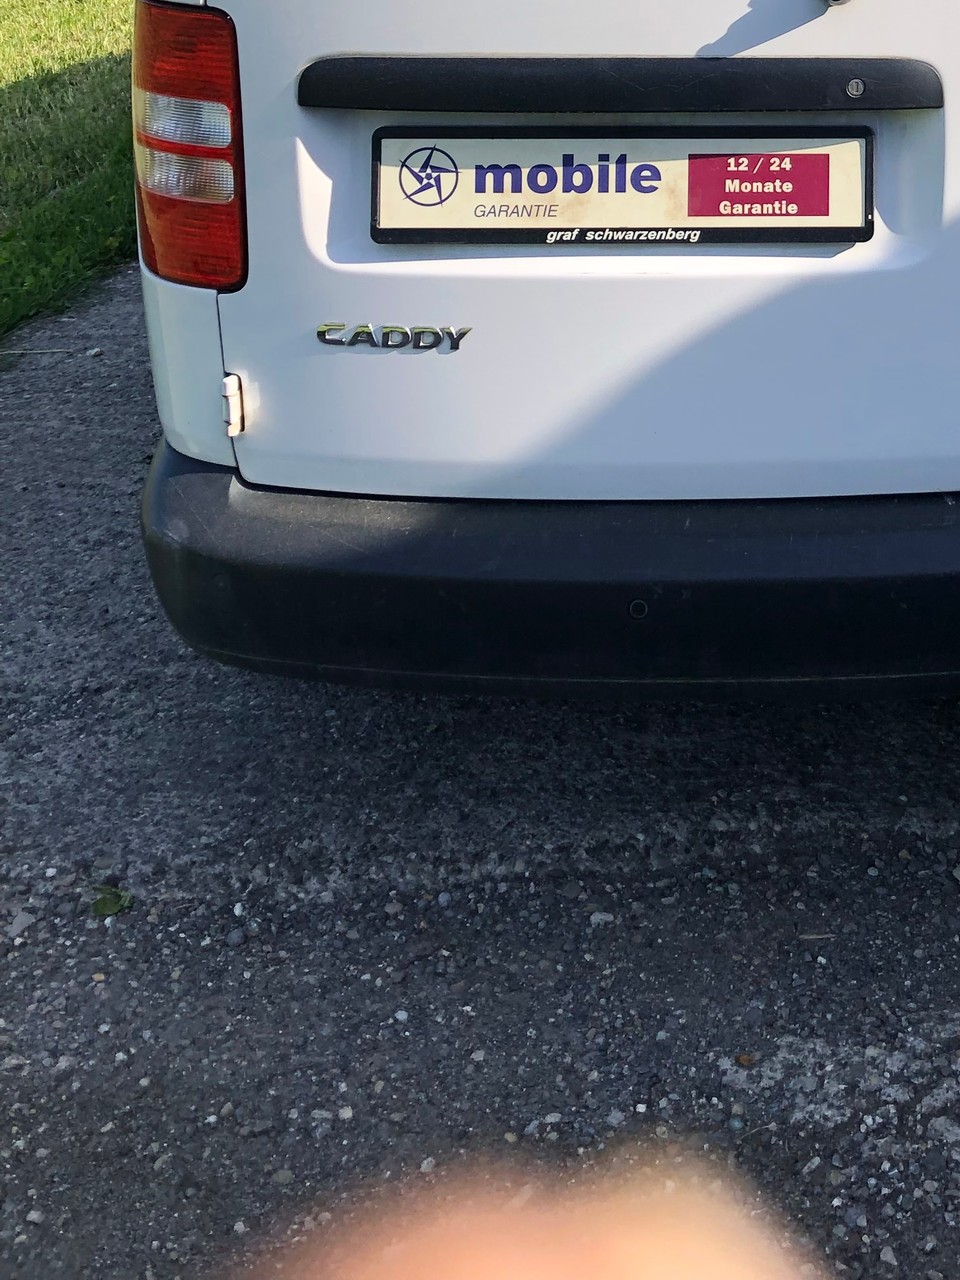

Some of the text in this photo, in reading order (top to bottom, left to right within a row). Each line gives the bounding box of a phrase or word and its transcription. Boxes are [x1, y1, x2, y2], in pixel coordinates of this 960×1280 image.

[726, 157, 749, 171] 12
[769, 157, 792, 171] 24
[474, 153, 662, 194] mobile
[724, 179, 793, 193] Monate
[474, 204, 559, 218] GARANTIE
[719, 200, 798, 215] Garantie
[546, 228, 701, 243] graf schwarzenberg
[316, 322, 473, 350] CADDY
